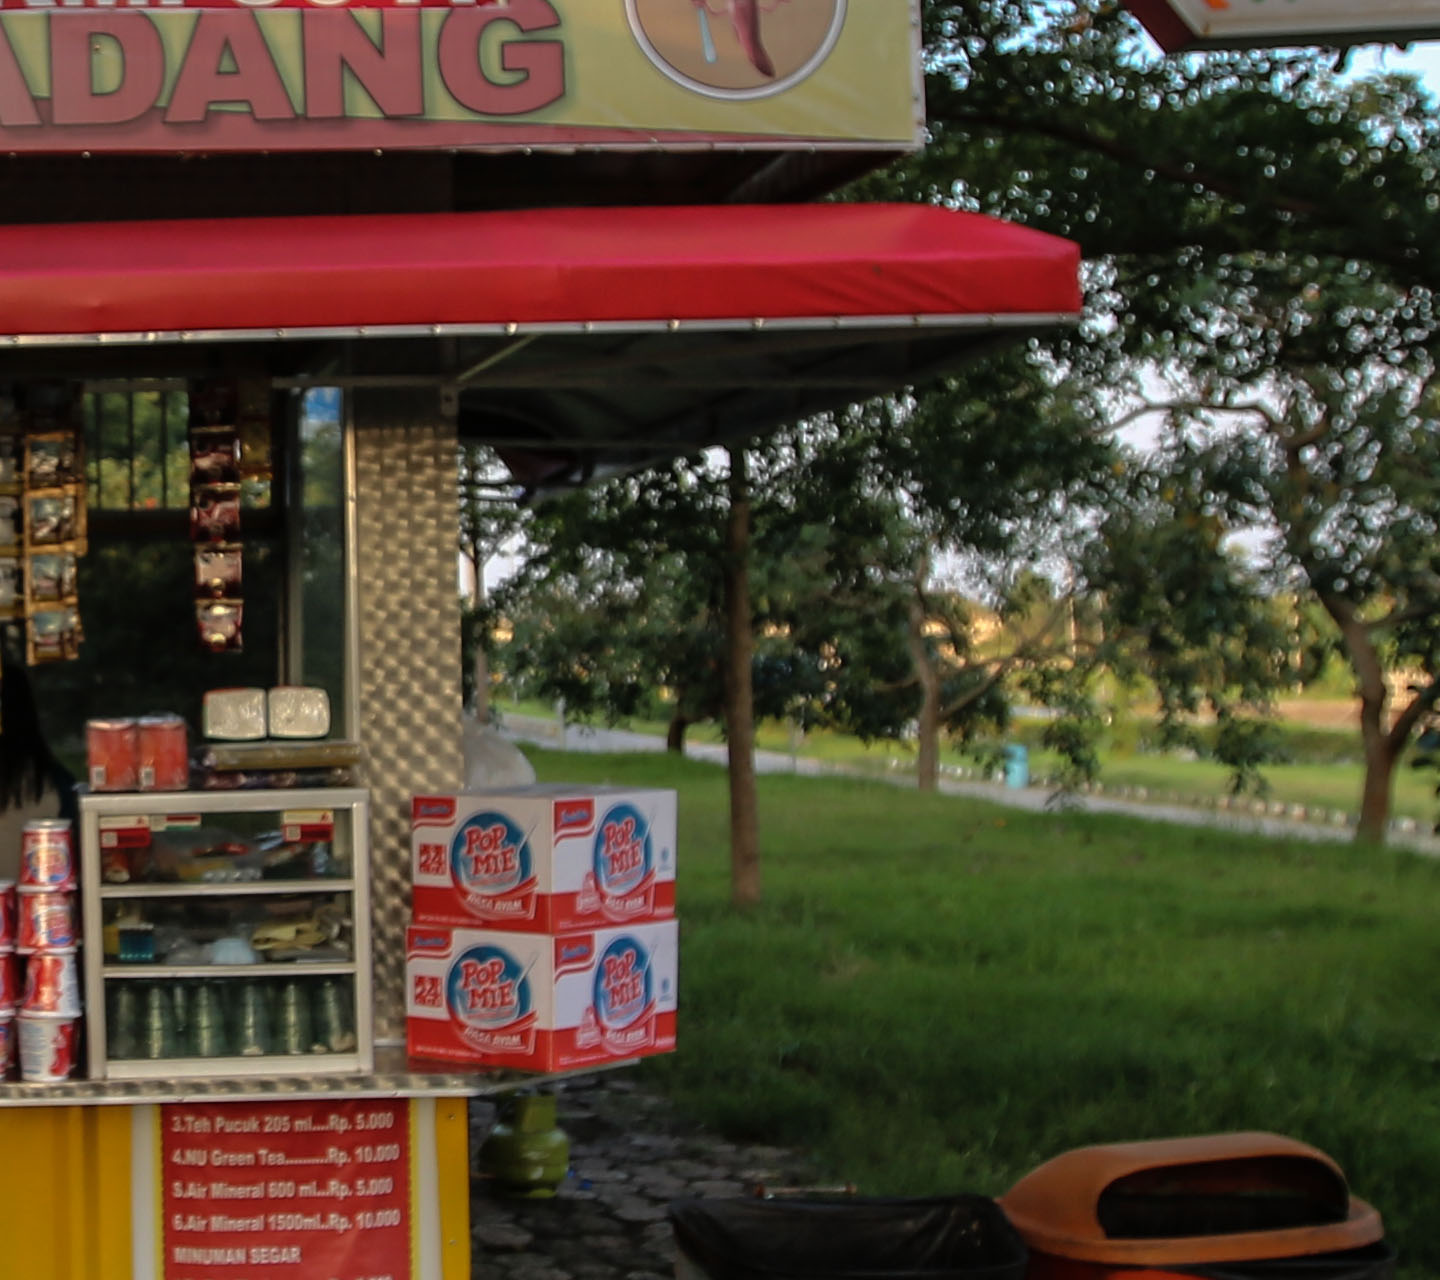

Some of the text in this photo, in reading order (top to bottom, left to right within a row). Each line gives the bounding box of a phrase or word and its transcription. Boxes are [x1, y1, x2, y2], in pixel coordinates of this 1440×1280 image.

[465, 825, 507, 857] POP
[604, 819, 635, 857] POP
[472, 848, 516, 876] MIE
[610, 841, 642, 876] MIE
[462, 959, 505, 991] POP
[604, 951, 635, 989] POP
[469, 981, 515, 1010] MIE
[610, 972, 643, 1009] MIE
[215, 1117, 260, 1133] Pucuk
[264, 1116, 291, 1132] 205
[354, 1112, 394, 1130] 5.000
[211, 1150, 256, 1166] Green
[354, 1144, 400, 1163] 10.000
[210, 1183, 265, 1199] Mineral
[354, 1178, 393, 1196] 5.000
[210, 1215, 265, 1232] Mineral
[355, 1210, 401, 1230] 10.000
[173, 1247, 301, 1265] MINUMAN SEGAR
